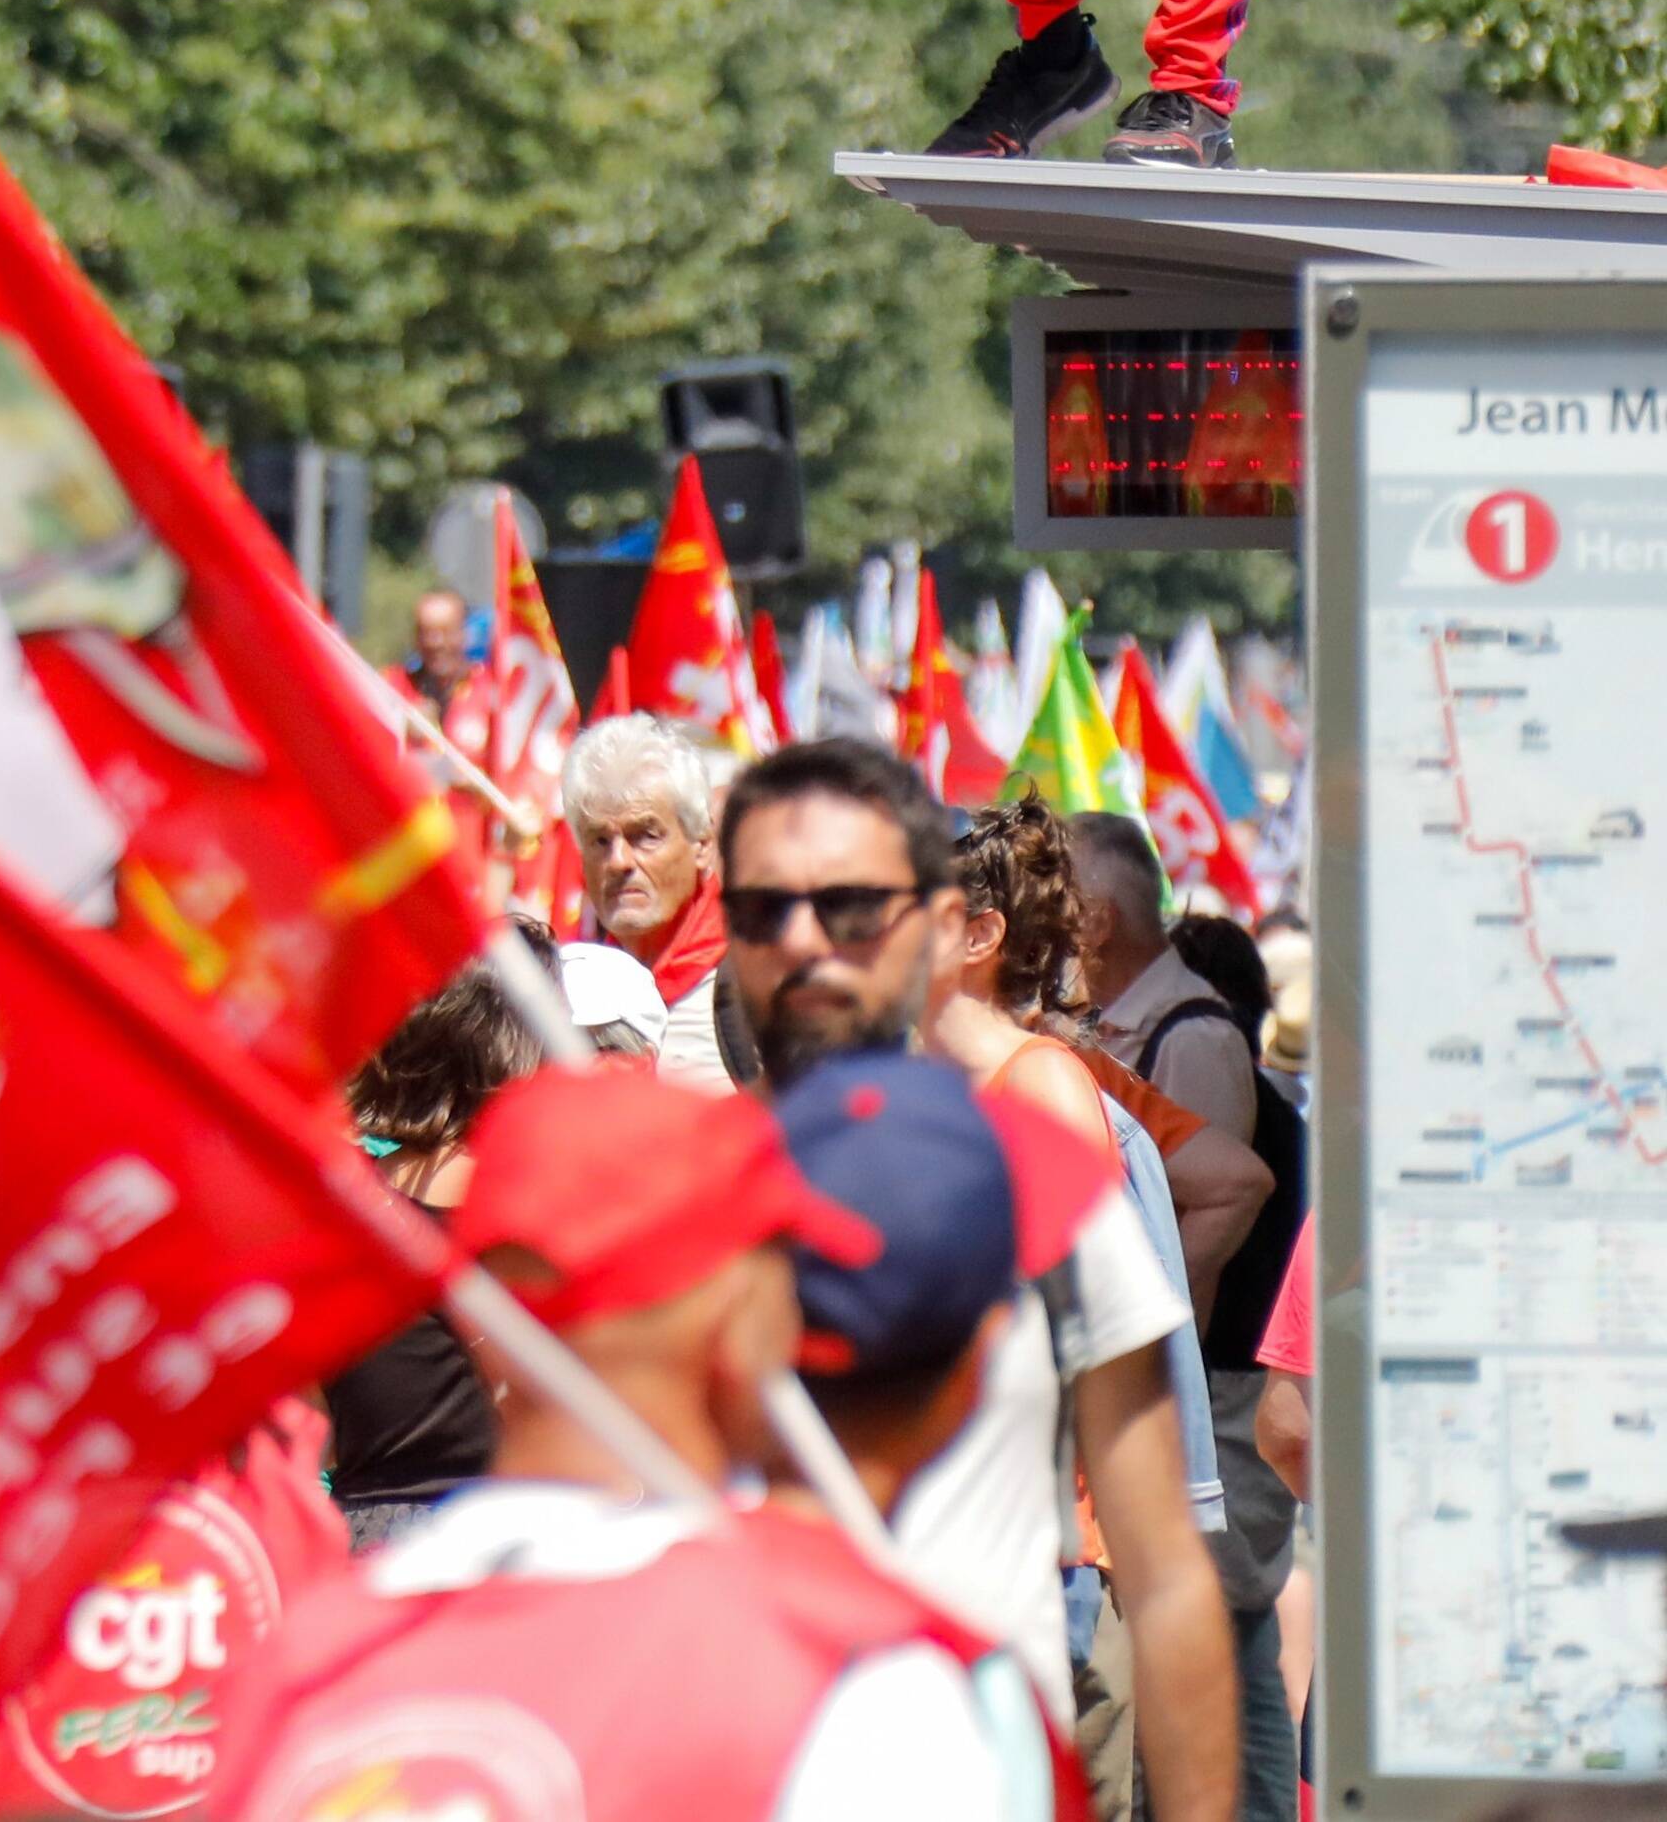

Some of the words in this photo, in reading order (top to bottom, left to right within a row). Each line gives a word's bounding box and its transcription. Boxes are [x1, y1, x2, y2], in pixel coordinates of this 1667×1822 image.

[1457, 386, 1589, 435] Jean
[1488, 499, 1528, 574] 1
[69, 1572, 226, 1689] cgt
[53, 1687, 219, 1760] FERC
